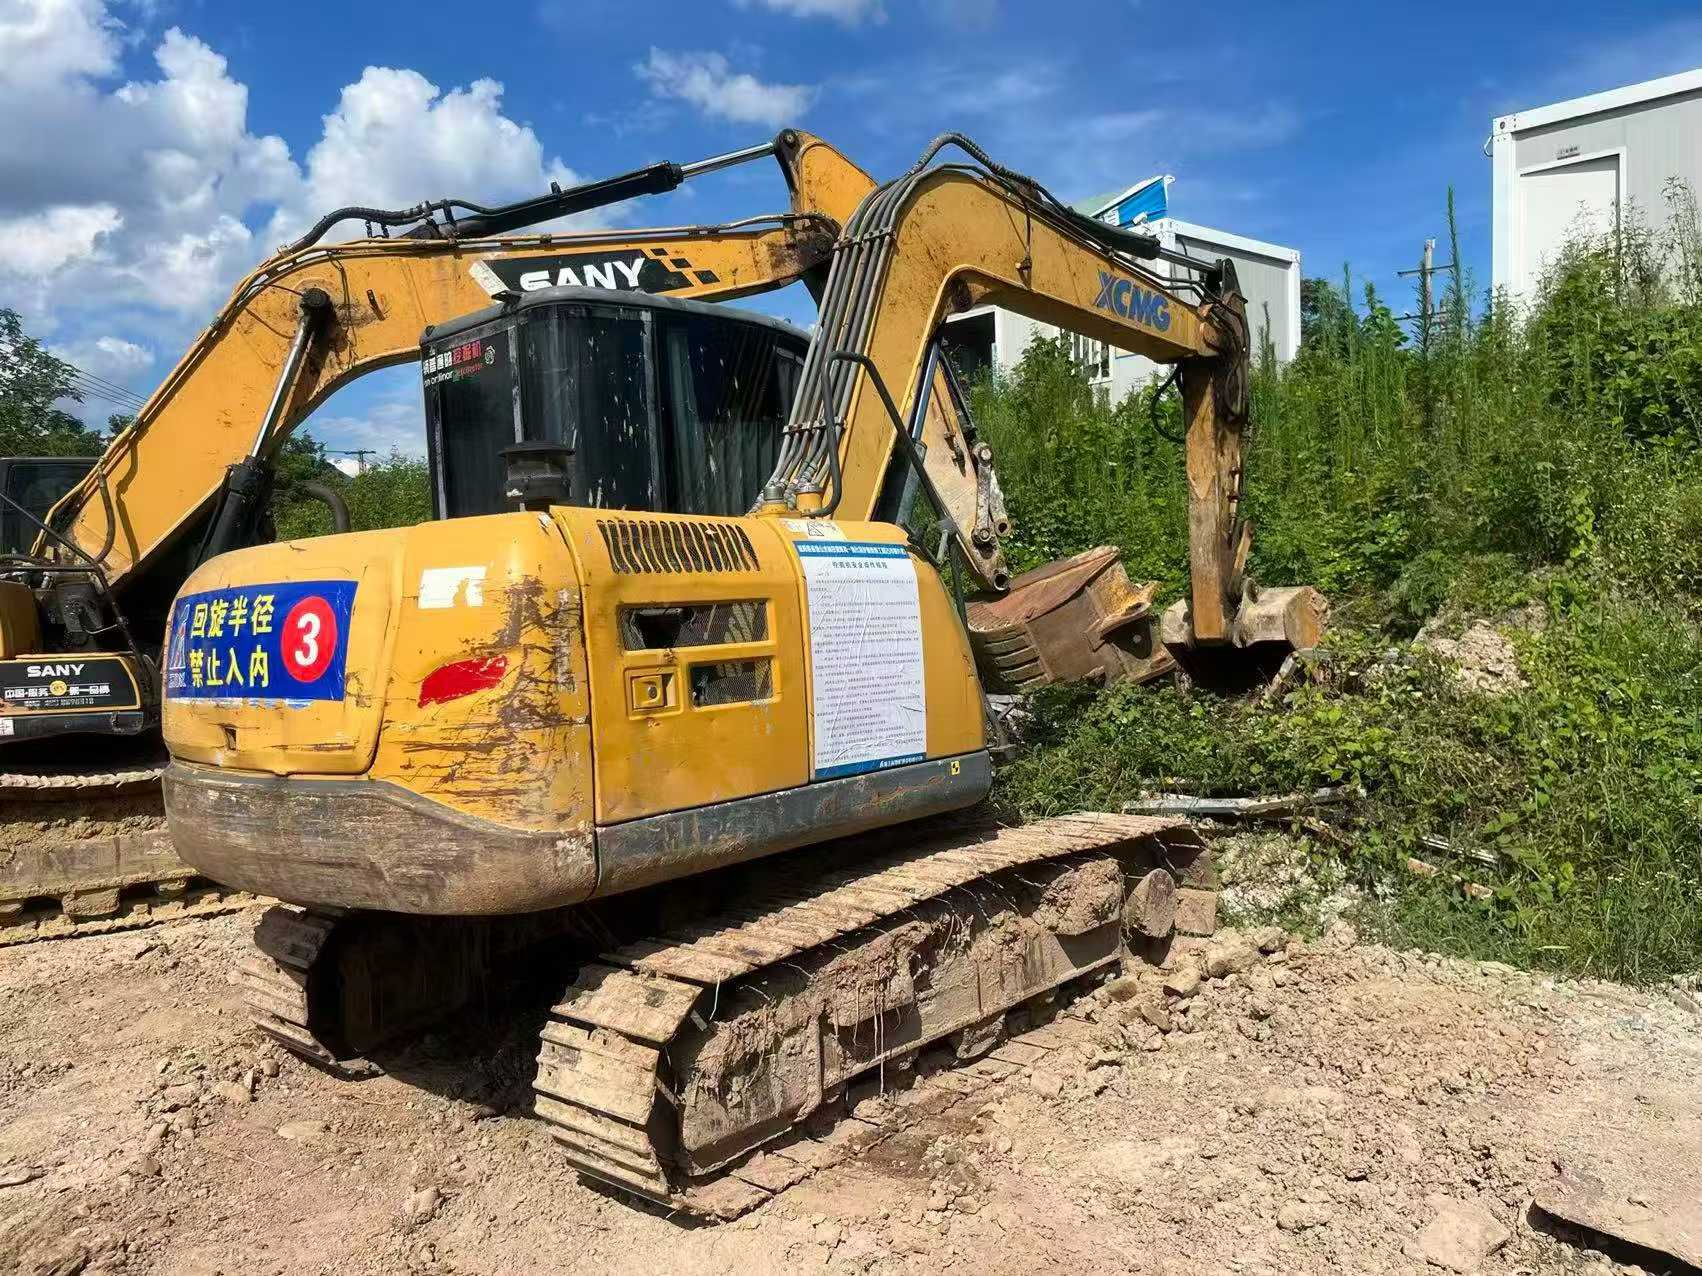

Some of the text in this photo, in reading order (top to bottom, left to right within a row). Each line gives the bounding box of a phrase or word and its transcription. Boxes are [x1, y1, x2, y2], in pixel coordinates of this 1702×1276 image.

[519, 257, 645, 292] SANY
[1093, 270, 1171, 332] XCMG
[190, 594, 275, 638] 回旋半径
[294, 612, 321, 666] 3
[27, 663, 85, 678] SANY
[188, 645, 269, 688] 禁止入内
